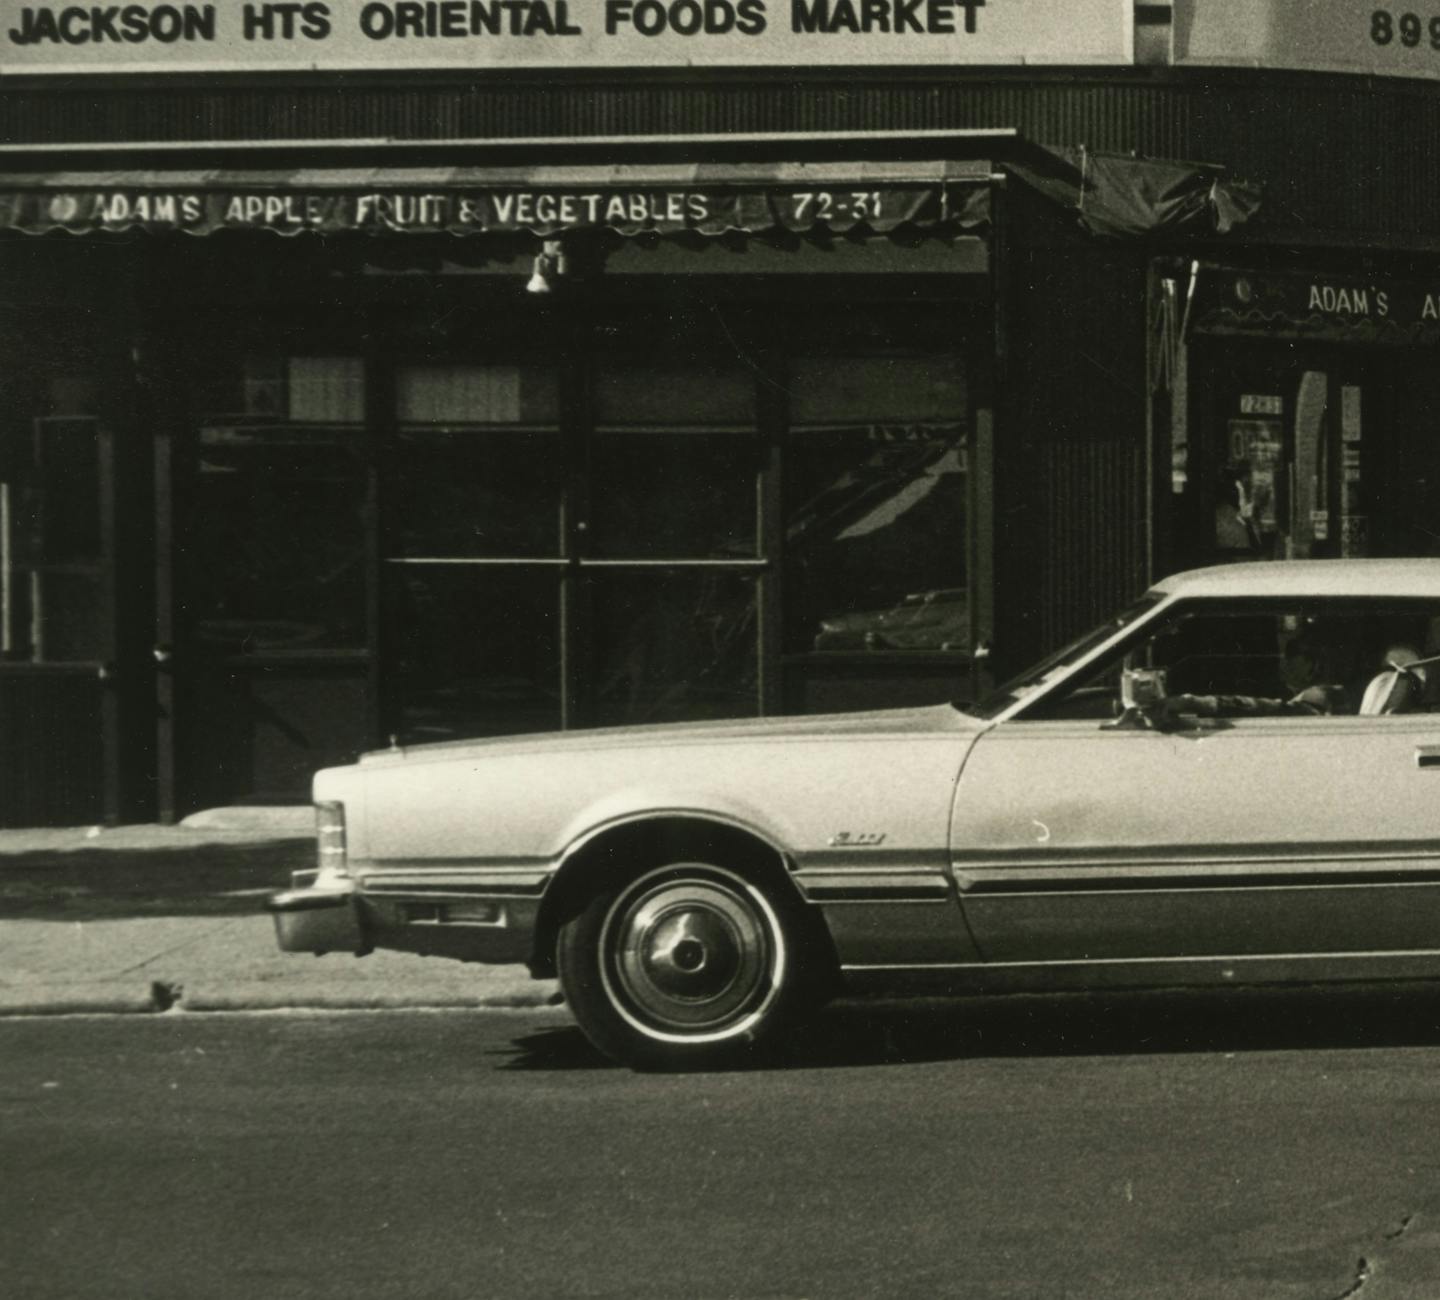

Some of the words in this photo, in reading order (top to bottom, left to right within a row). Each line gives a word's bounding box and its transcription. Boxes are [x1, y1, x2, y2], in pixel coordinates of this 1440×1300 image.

[9, 4, 215, 45] JACKSON
[244, 2, 330, 41] HTS
[360, 0, 581, 40] ORIENTAL
[605, 0, 767, 37] FOODS
[791, 0, 985, 34] MARKET
[91, 193, 201, 222] ADAM'S
[225, 194, 322, 223] APPLE
[356, 193, 446, 223] FRUIT
[492, 194, 709, 223] VEGETABLES
[792, 191, 881, 220] 72-31
[1309, 285, 1388, 316] ADAM'S
